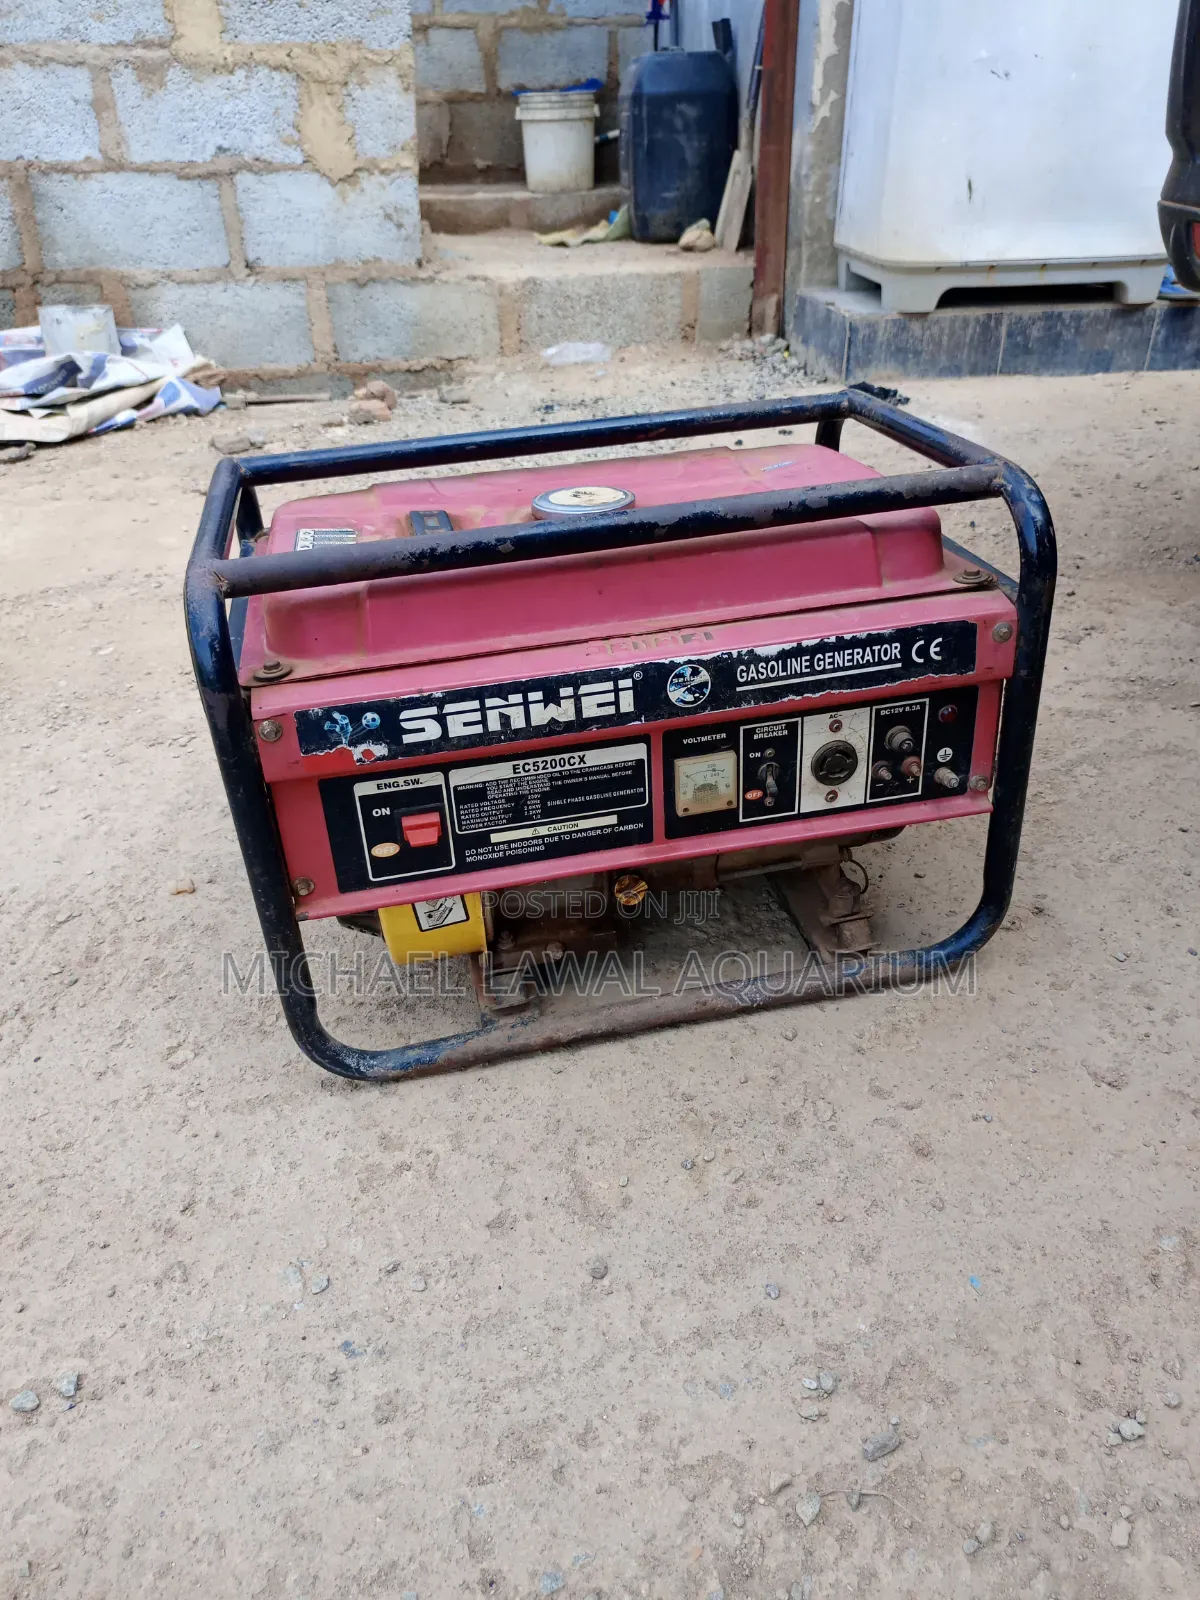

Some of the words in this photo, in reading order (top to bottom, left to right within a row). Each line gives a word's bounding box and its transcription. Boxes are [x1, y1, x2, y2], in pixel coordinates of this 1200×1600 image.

[737, 655, 811, 683] GASOLINE
[814, 642, 901, 670] GENERATOR
[912, 637, 943, 663] CE
[880, 706, 904, 716] DC12V
[905, 704, 921, 713] 8.3A
[753, 729, 788, 740] BREAKER
[755, 723, 786, 734] CIRCUIT
[682, 732, 727, 745] VOLTMETER
[748, 751, 762, 759] ON
[512, 753, 587, 775] EC5200CX
[614, 760, 637, 769] BEFORE
[611, 769, 633, 778] BEFORE
[376, 778, 423, 790] ENG.SW.
[567, 795, 585, 804] PHASE
[585, 791, 613, 801] GASOLINE
[612, 787, 644, 797] GENERATOR
[747, 791, 762, 799] OFF
[459, 801, 479, 810] RATED
[480, 798, 506, 807] VOLTAGE
[460, 807, 480, 816] RATED
[480, 802, 515, 812] FREQUENCY
[372, 807, 391, 817] ON
[461, 812, 480, 821] RATED
[480, 809, 503, 817] OUTPUT
[461, 816, 489, 825] MAXIMUM
[489, 813, 513, 821] OUTPUT
[462, 822, 484, 831] POWER
[547, 822, 579, 833] CAUTION
[465, 848, 477, 857] DO
[477, 846, 493, 855] NOT
[494, 843, 509, 852] USE
[510, 838, 543, 849] INDOORS
[544, 836, 559, 844] DUE
[571, 829, 602, 840] DANGER
[601, 827, 613, 835] OF
[614, 823, 644, 833] CARBON
[374, 845, 396, 855] OFF
[466, 852, 504, 863] MONOXIDE
[505, 845, 545, 857] POISONING
